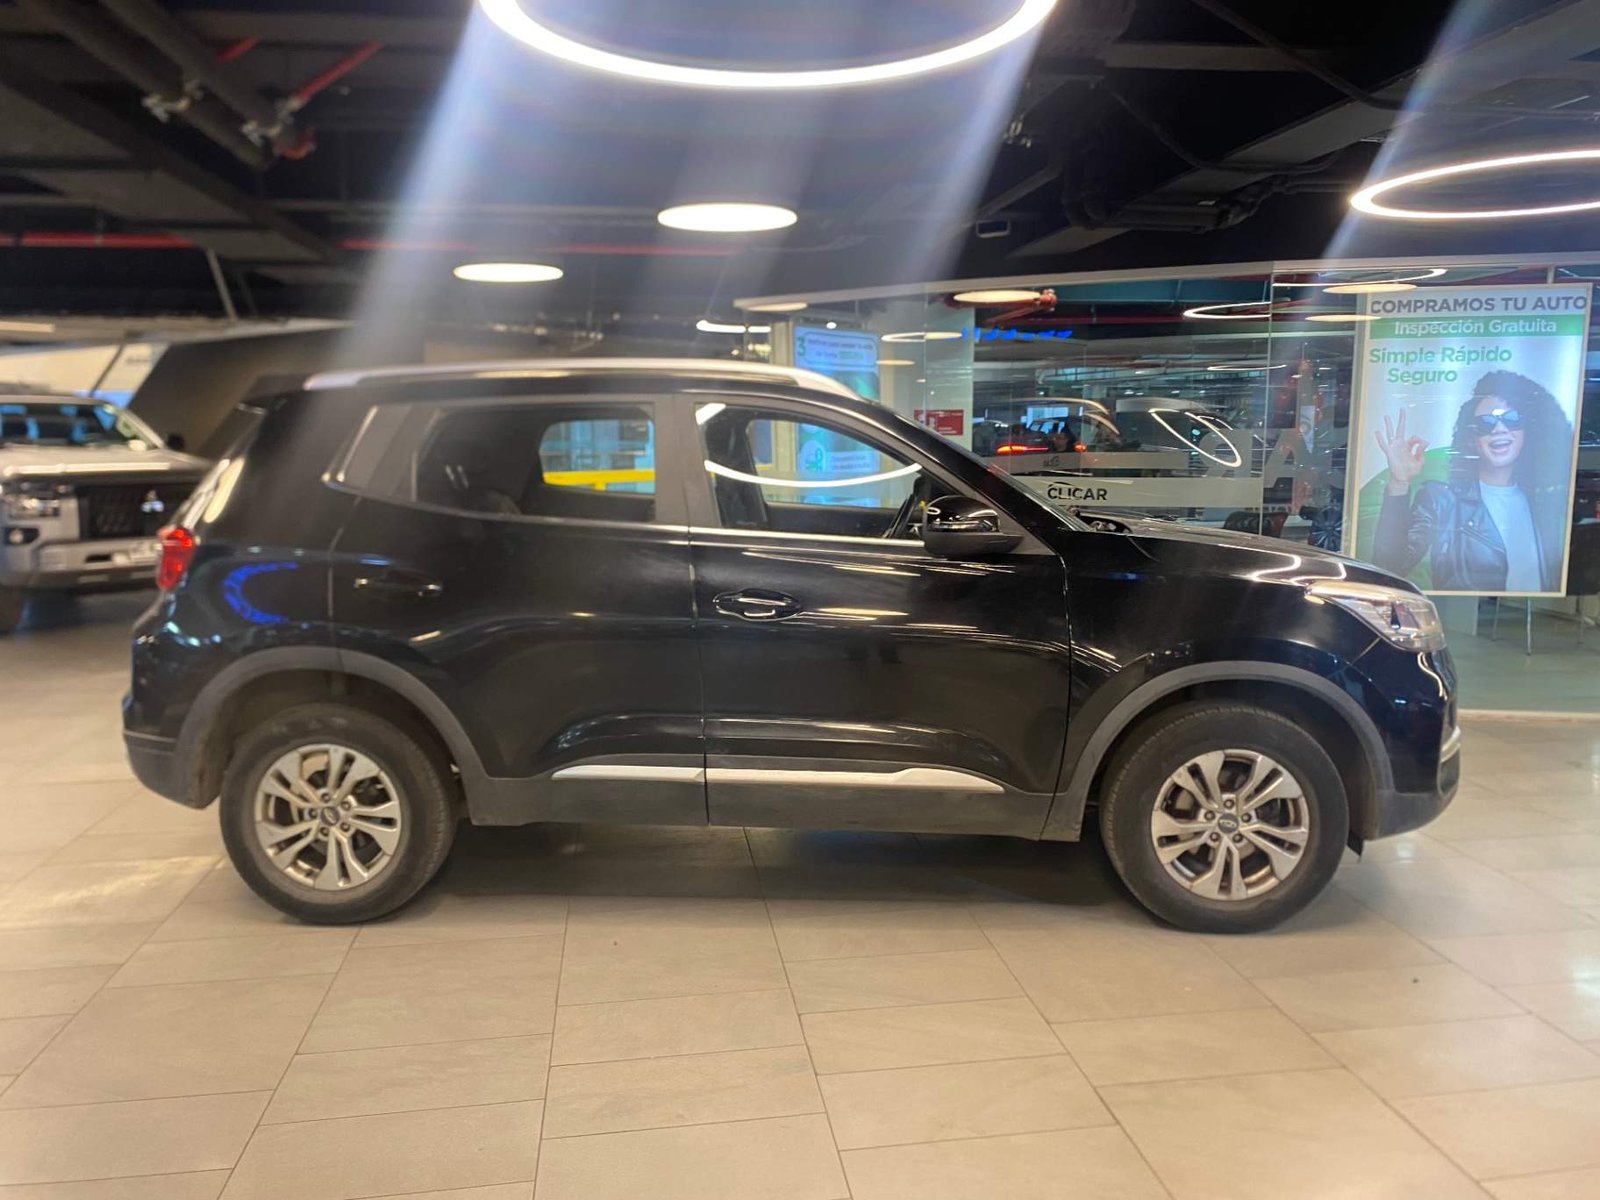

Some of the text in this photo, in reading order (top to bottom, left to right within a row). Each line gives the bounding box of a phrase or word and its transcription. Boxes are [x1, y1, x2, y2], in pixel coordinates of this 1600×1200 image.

[1371, 296, 1586, 315] COMPRAMOS TU AUTO
[1395, 318, 1556, 336] Inspección Gratuita
[1369, 346, 1512, 366] Simple Rápido
[1387, 368, 1457, 386] Seguro
[1048, 486, 1108, 501] CLICAR
